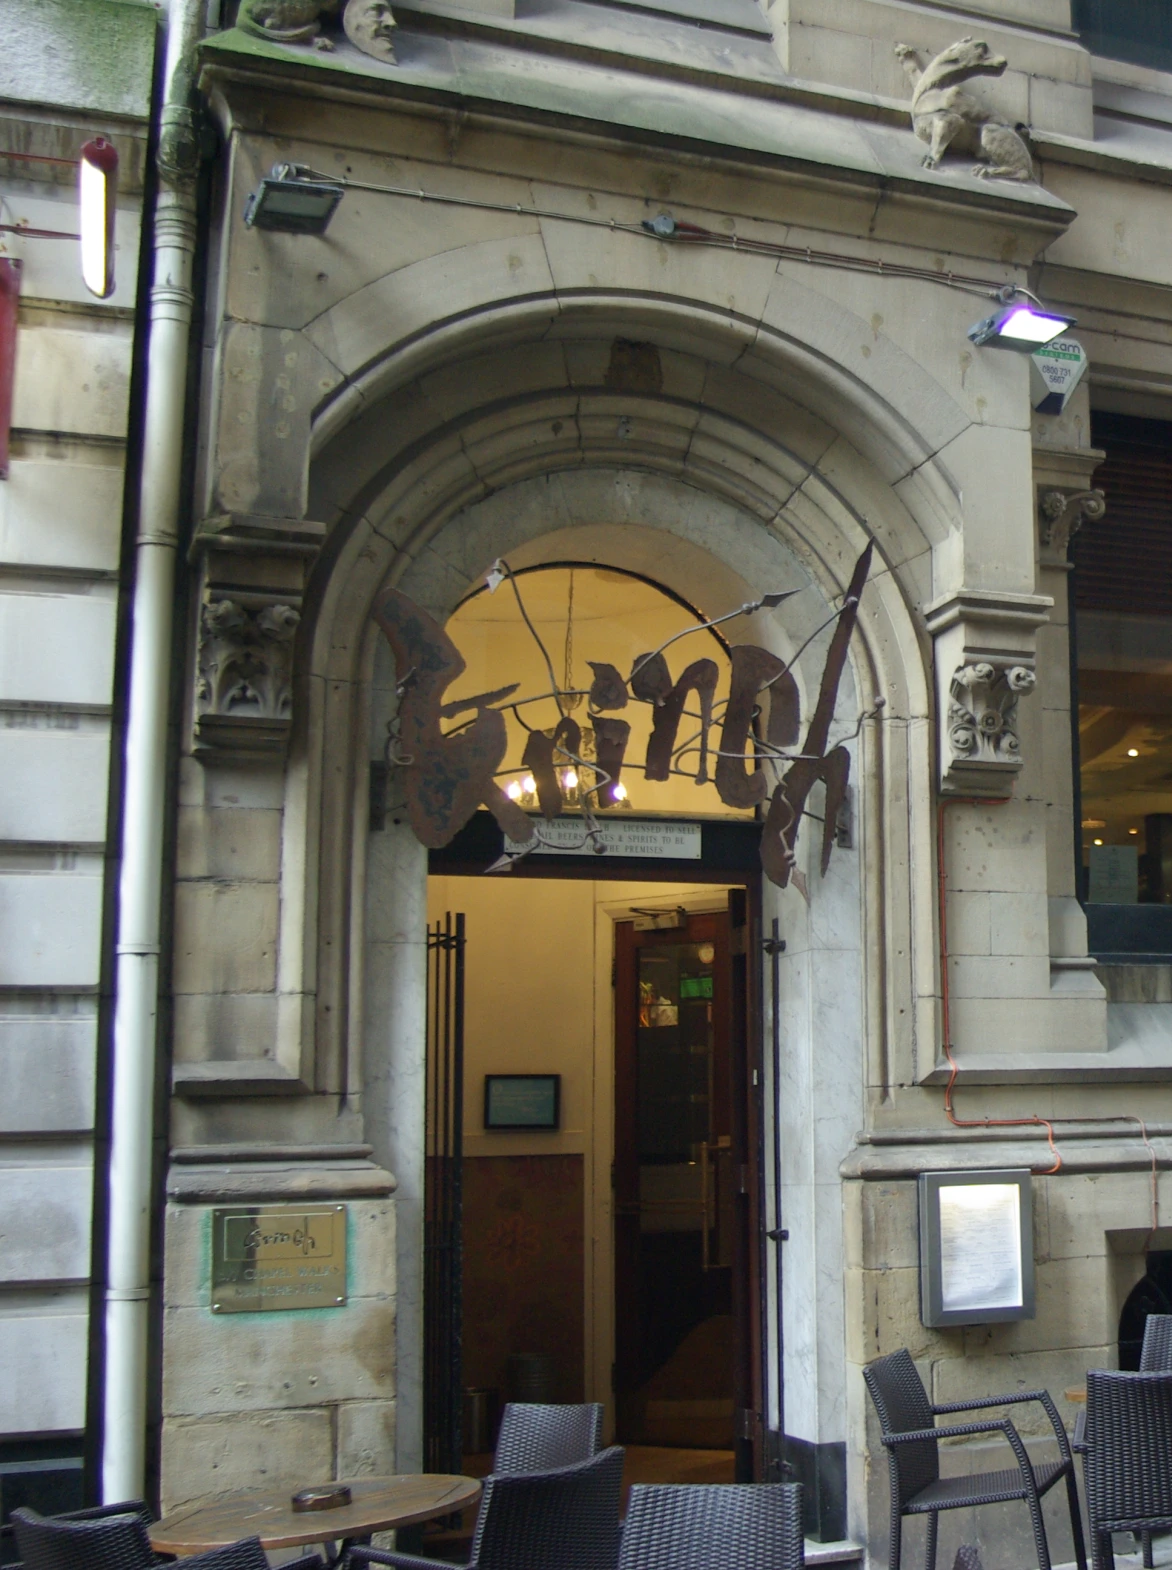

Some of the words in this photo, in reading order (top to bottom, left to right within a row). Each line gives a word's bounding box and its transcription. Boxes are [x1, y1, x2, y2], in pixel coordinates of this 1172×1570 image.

[623, 824, 661, 834] LICENSED
[558, 832, 583, 841] BEERS
[628, 834, 657, 844] SPIRITS
[625, 845, 664, 854] PREMISES
